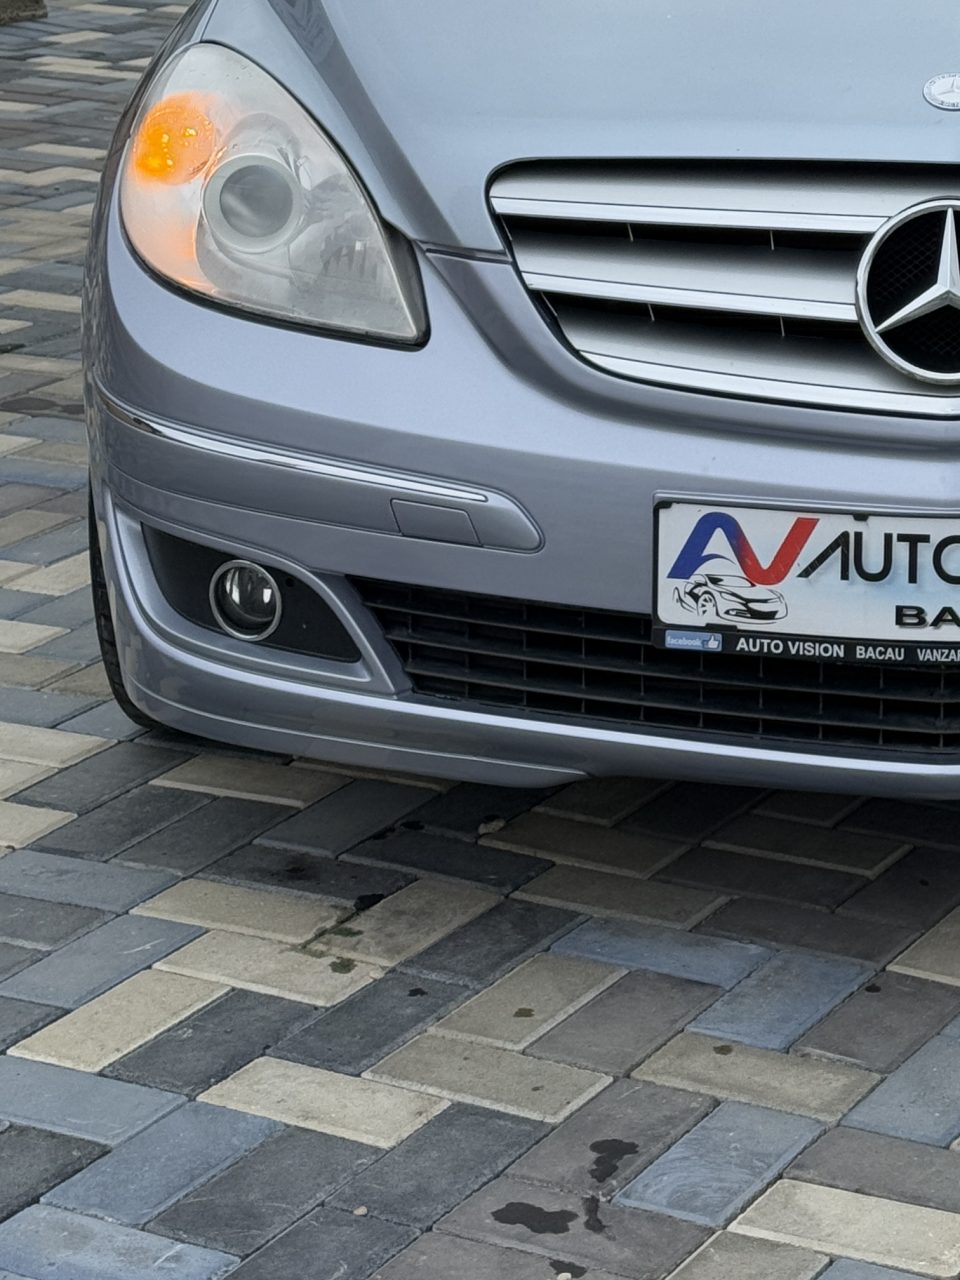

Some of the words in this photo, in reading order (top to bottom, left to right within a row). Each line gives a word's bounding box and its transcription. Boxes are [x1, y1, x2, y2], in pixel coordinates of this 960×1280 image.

[736, 637, 784, 654] AUTO
[787, 640, 845, 658] VISION
[855, 645, 905, 661] BACAU
